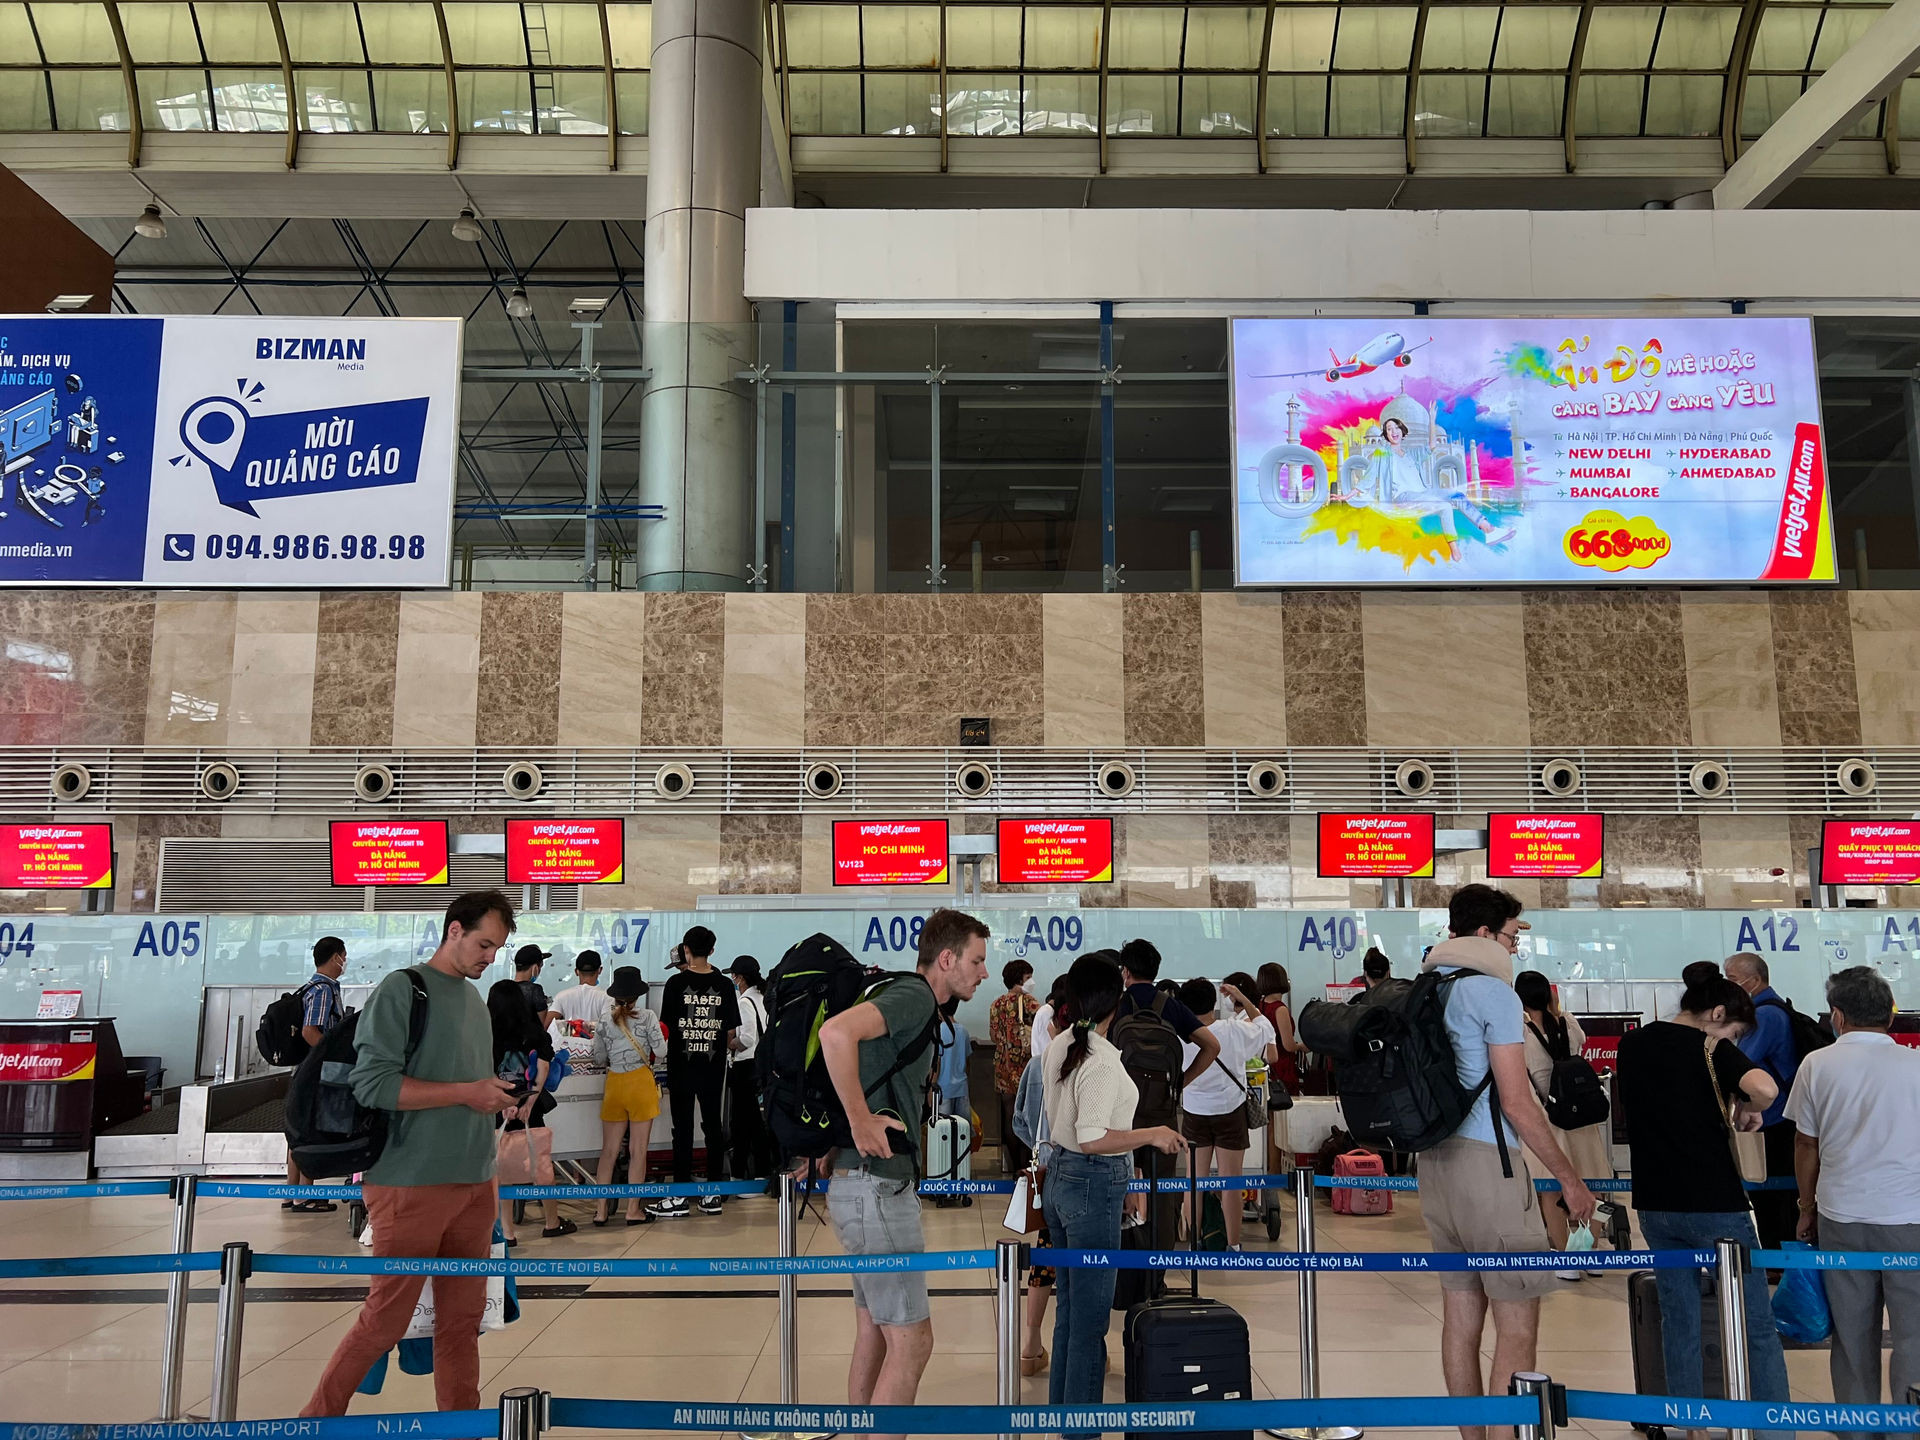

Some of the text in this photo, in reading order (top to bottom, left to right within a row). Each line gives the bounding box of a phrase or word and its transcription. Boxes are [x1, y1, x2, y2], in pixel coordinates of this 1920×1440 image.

[256, 338, 366, 360] BIZMAN
[22, 354, 50, 370] DỊCH
[54, 354, 71, 370] VỤ
[337, 363, 364, 371] Media
[1666, 353, 1697, 376] MÊ
[1700, 349, 1756, 376] HOẶC
[28, 370, 53, 386] CÁO
[1552, 379, 1775, 419] CÀNG BAY CÀNG YÊU
[304, 415, 355, 450] MỜI
[1567, 432, 1580, 442] Hà
[1583, 432, 1598, 443] Nội
[1606, 432, 1620, 442] TP.
[1654, 431, 1676, 442] Minh
[1684, 431, 1696, 442] Đà
[1730, 430, 1747, 442] Phú
[1750, 430, 1773, 443] Quốc
[1568, 448, 1651, 459] NEW DELHI
[1679, 448, 1772, 460] HYDERABAD
[245, 444, 401, 488] QUẢNG CÁO
[1569, 467, 1631, 479] MUMBAI
[1679, 467, 1777, 479] AHMEDABAD
[1569, 486, 1660, 499] BANGALORE
[0, 542, 73, 557] nmedia.vn
[205, 534, 426, 560] 094.986.98.98
[863, 845, 925, 854] HO CHI MINH
[838, 860, 864, 868] VJ123
[919, 859, 942, 867] 09:35
[132, 921, 200, 957] A05
[589, 918, 650, 954] A07
[862, 916, 926, 952] A08
[1022, 916, 1083, 951] A09
[1298, 917, 1357, 952] A10
[1736, 917, 1800, 952] A12
[683, 994, 722, 1006] BASED
[694, 1006, 710, 1017] IN
[678, 1017, 723, 1030] SAIGON
[682, 1029, 717, 1041] SINCE
[688, 1042, 710, 1052] 2016
[216, 1185, 241, 1195] N.I.A
[923, 1181, 948, 1192] QUỐC
[963, 1182, 979, 1193] NỘI
[1196, 1178, 1266, 1189] IRPORT N.I.A
[27, 1186, 70, 1197] AIRPORT
[96, 1186, 121, 1195] N.I.A
[516, 1188, 549, 1197] NOIBAI
[550, 1186, 626, 1197] INTERNATIONAL
[628, 1185, 671, 1195] AIRPORT
[317, 1259, 348, 1270] N.I.A
[709, 1261, 752, 1272] NOIBAI
[755, 1258, 855, 1271] INTERNATIONAL
[857, 1256, 911, 1268] AIRPORT
[1082, 1254, 1109, 1265] N.I.A
[1149, 1253, 1183, 1266] CẢNG
[1185, 1253, 1218, 1267] HÀNG
[1221, 1254, 1264, 1267] KHÔNG
[1320, 1255, 1341, 1270] NỘI
[1343, 1255, 1364, 1268] BÀI
[1401, 1257, 1429, 1267] N.I.A
[1467, 1257, 1508, 1267] NOIBAI
[1510, 1255, 1602, 1266] INTERNATIONAL
[1604, 1254, 1655, 1265] AIRPORT
[1815, 1254, 1847, 1266] N.I.A
[673, 1407, 1196, 1431] AN NINH HÀNG KHÔNG NỘI BÀI NOI BAI AVIATION SECURITY
[1665, 1402, 1712, 1421] N.I.A
[1766, 1405, 1821, 1425] CẢNG
[1825, 1407, 1881, 1426] HÀNG
[238, 1420, 323, 1438] AIRPORT
[376, 1418, 423, 1434] N.I.A
